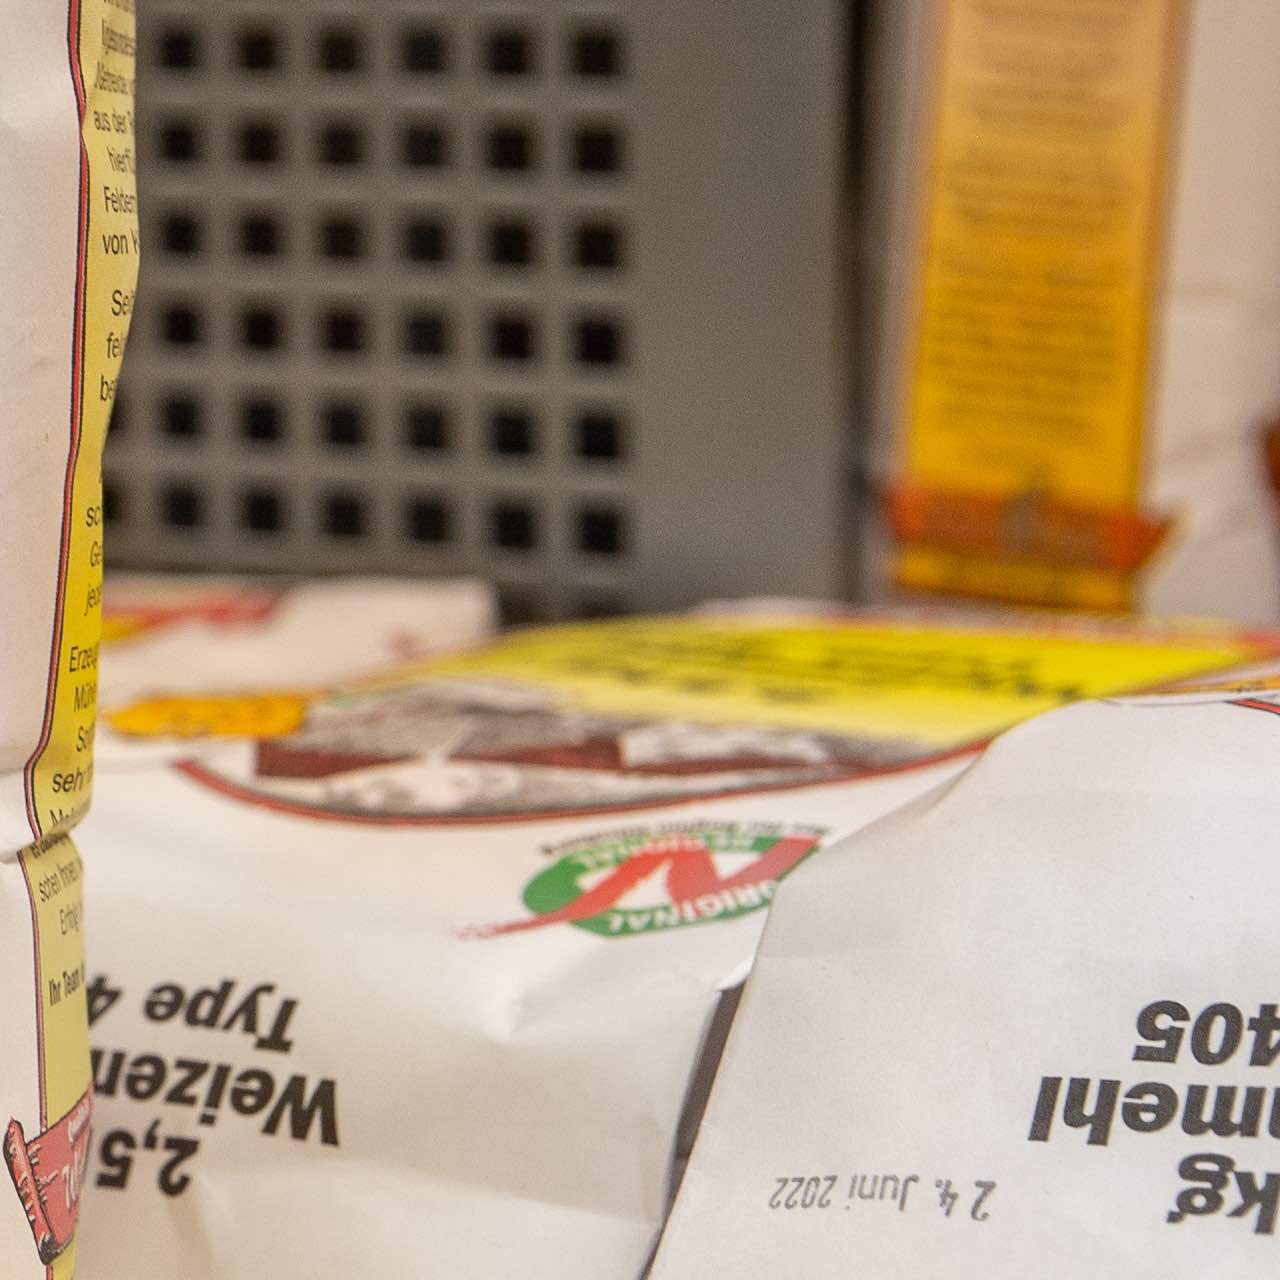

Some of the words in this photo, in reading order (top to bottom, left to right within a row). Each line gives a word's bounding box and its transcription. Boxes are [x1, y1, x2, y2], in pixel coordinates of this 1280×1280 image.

[102, 232, 129, 256] von
[143, 980, 300, 1054] Type
[96, 1118, 201, 1200] 2,5
[766, 1175, 839, 1211] 2022
[844, 1172, 919, 1213] Juni
[1165, 1151, 1280, 1236] kg
